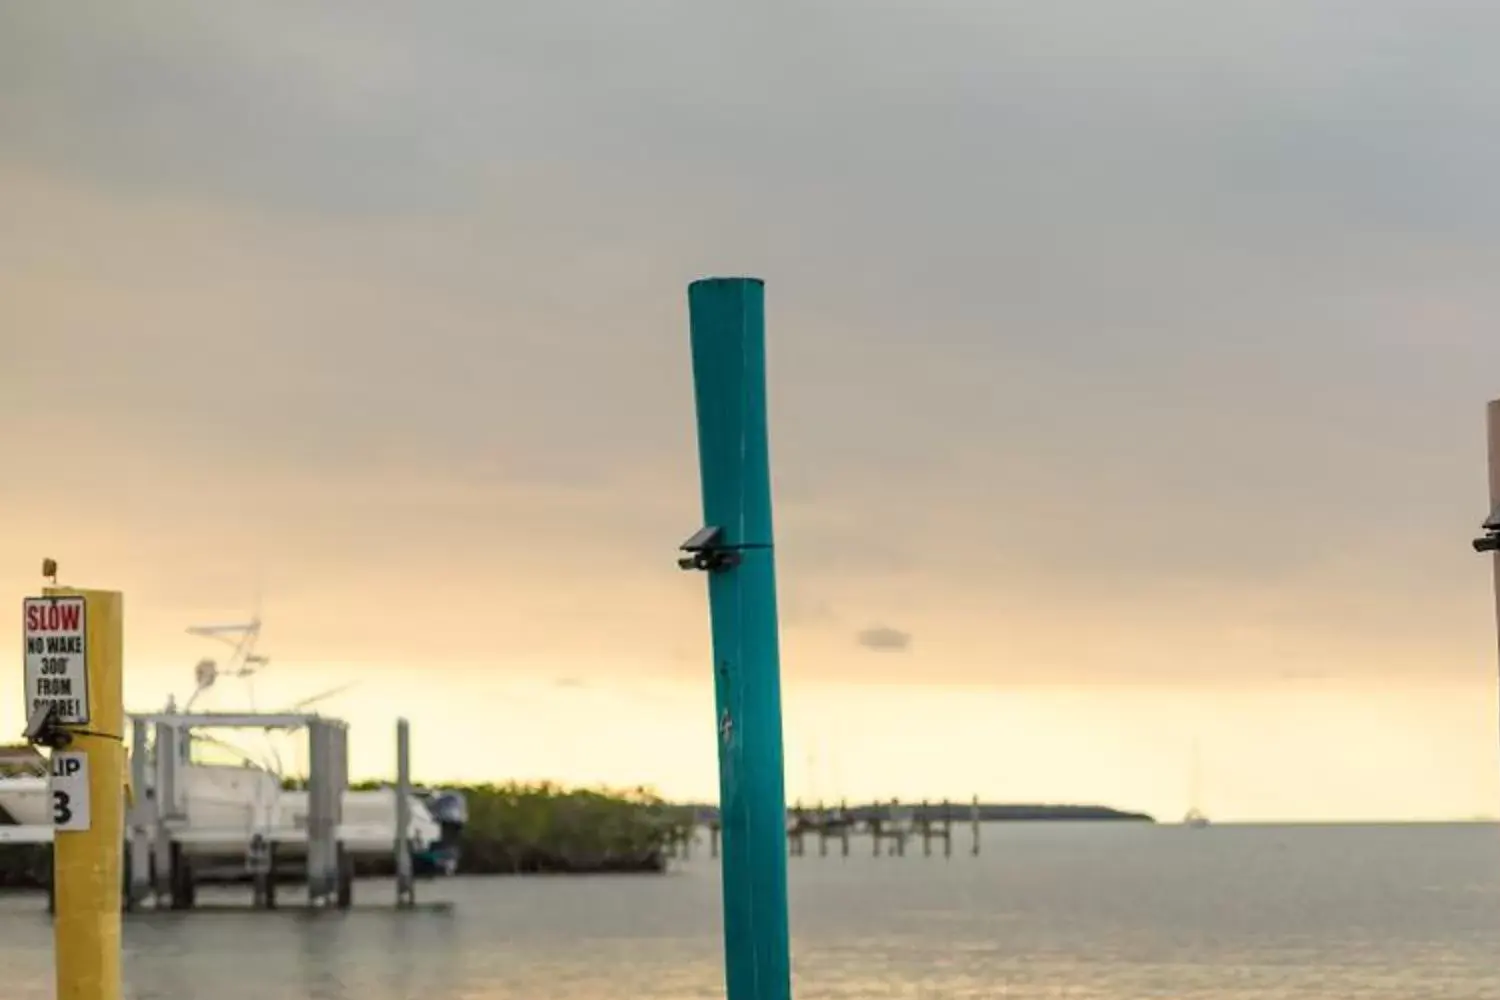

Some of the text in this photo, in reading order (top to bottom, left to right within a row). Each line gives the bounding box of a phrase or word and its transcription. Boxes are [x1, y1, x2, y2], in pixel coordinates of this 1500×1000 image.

[27, 604, 80, 631] SLOW
[27, 636, 82, 654] NO WAKE
[37, 677, 72, 696] FROM
[33, 698, 80, 717] SORE!
[51, 757, 81, 777] LIP
[53, 790, 72, 825] 3
